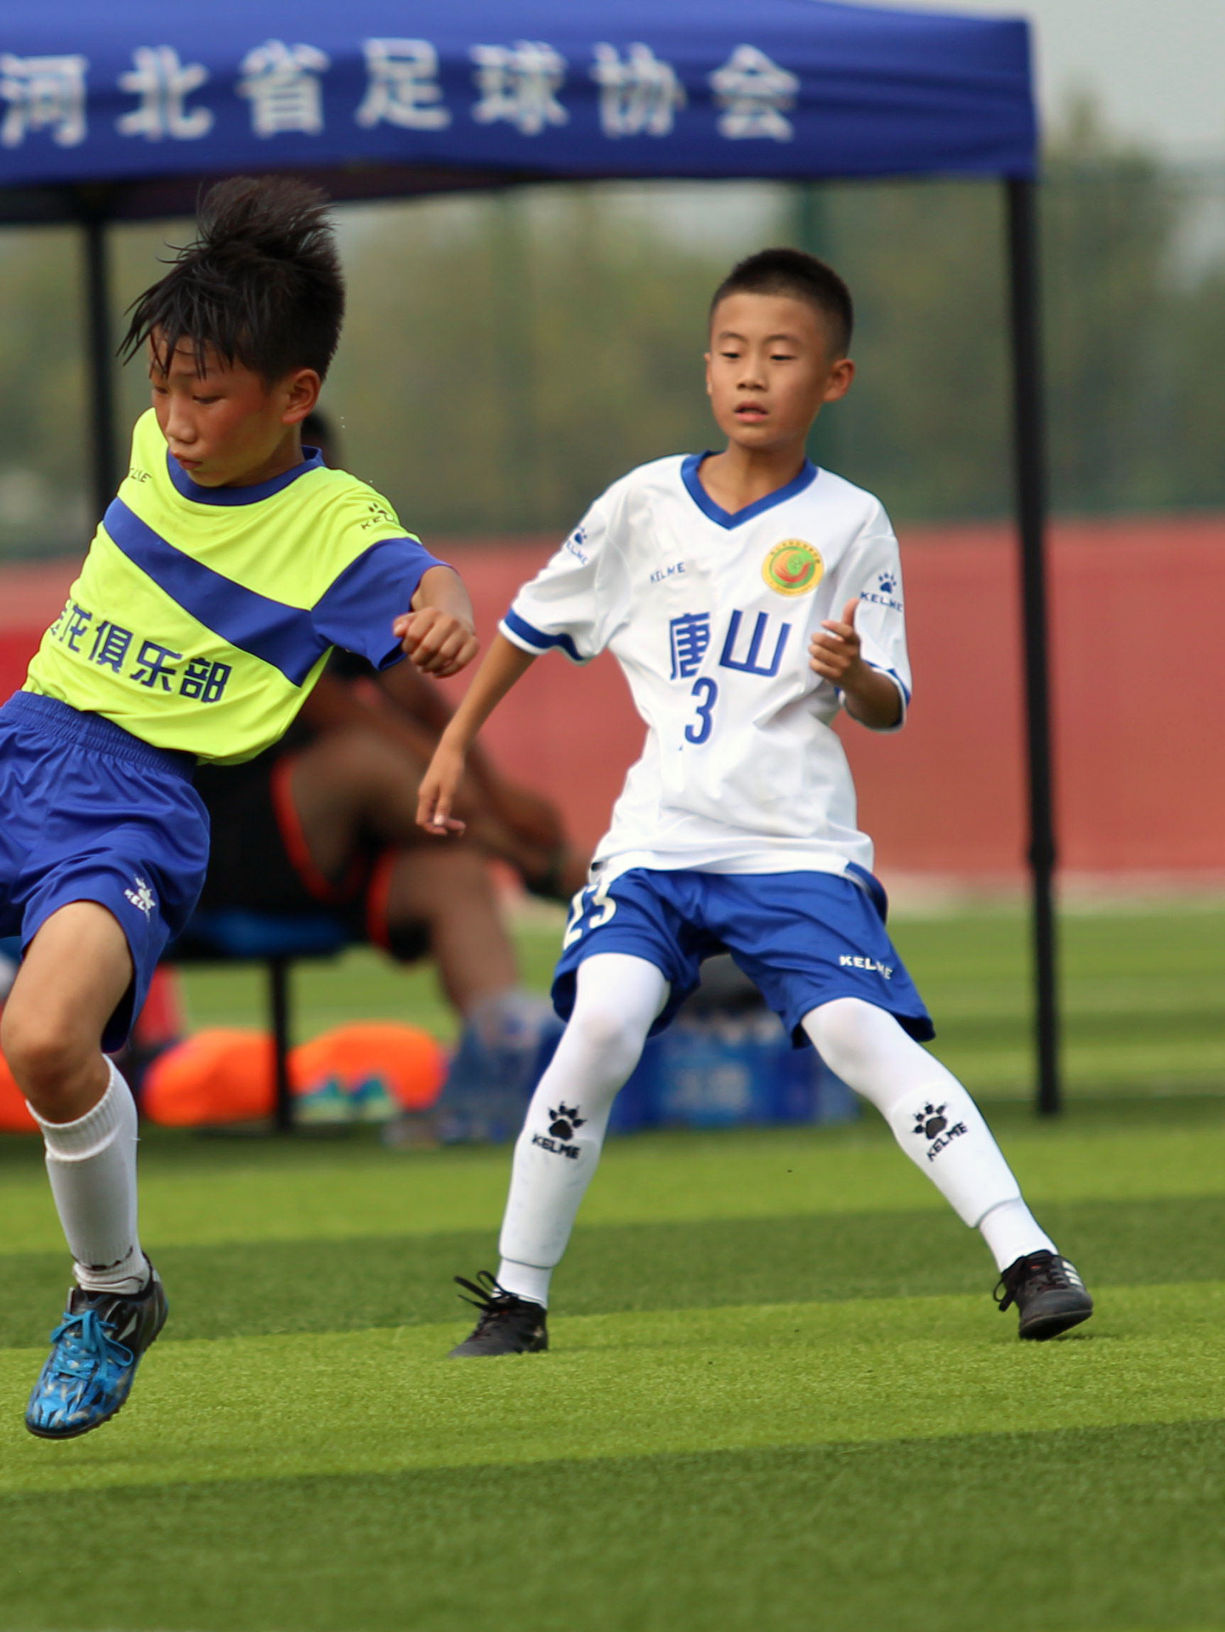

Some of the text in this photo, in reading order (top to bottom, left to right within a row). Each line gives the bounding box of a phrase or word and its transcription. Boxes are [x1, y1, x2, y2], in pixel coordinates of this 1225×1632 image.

[51, 602, 233, 704] 花俱乐部
[669, 608, 792, 681] 唐山
[839, 955, 894, 980] KELME
[531, 1132, 580, 1160] KELME
[926, 1120, 968, 1162] KELME
